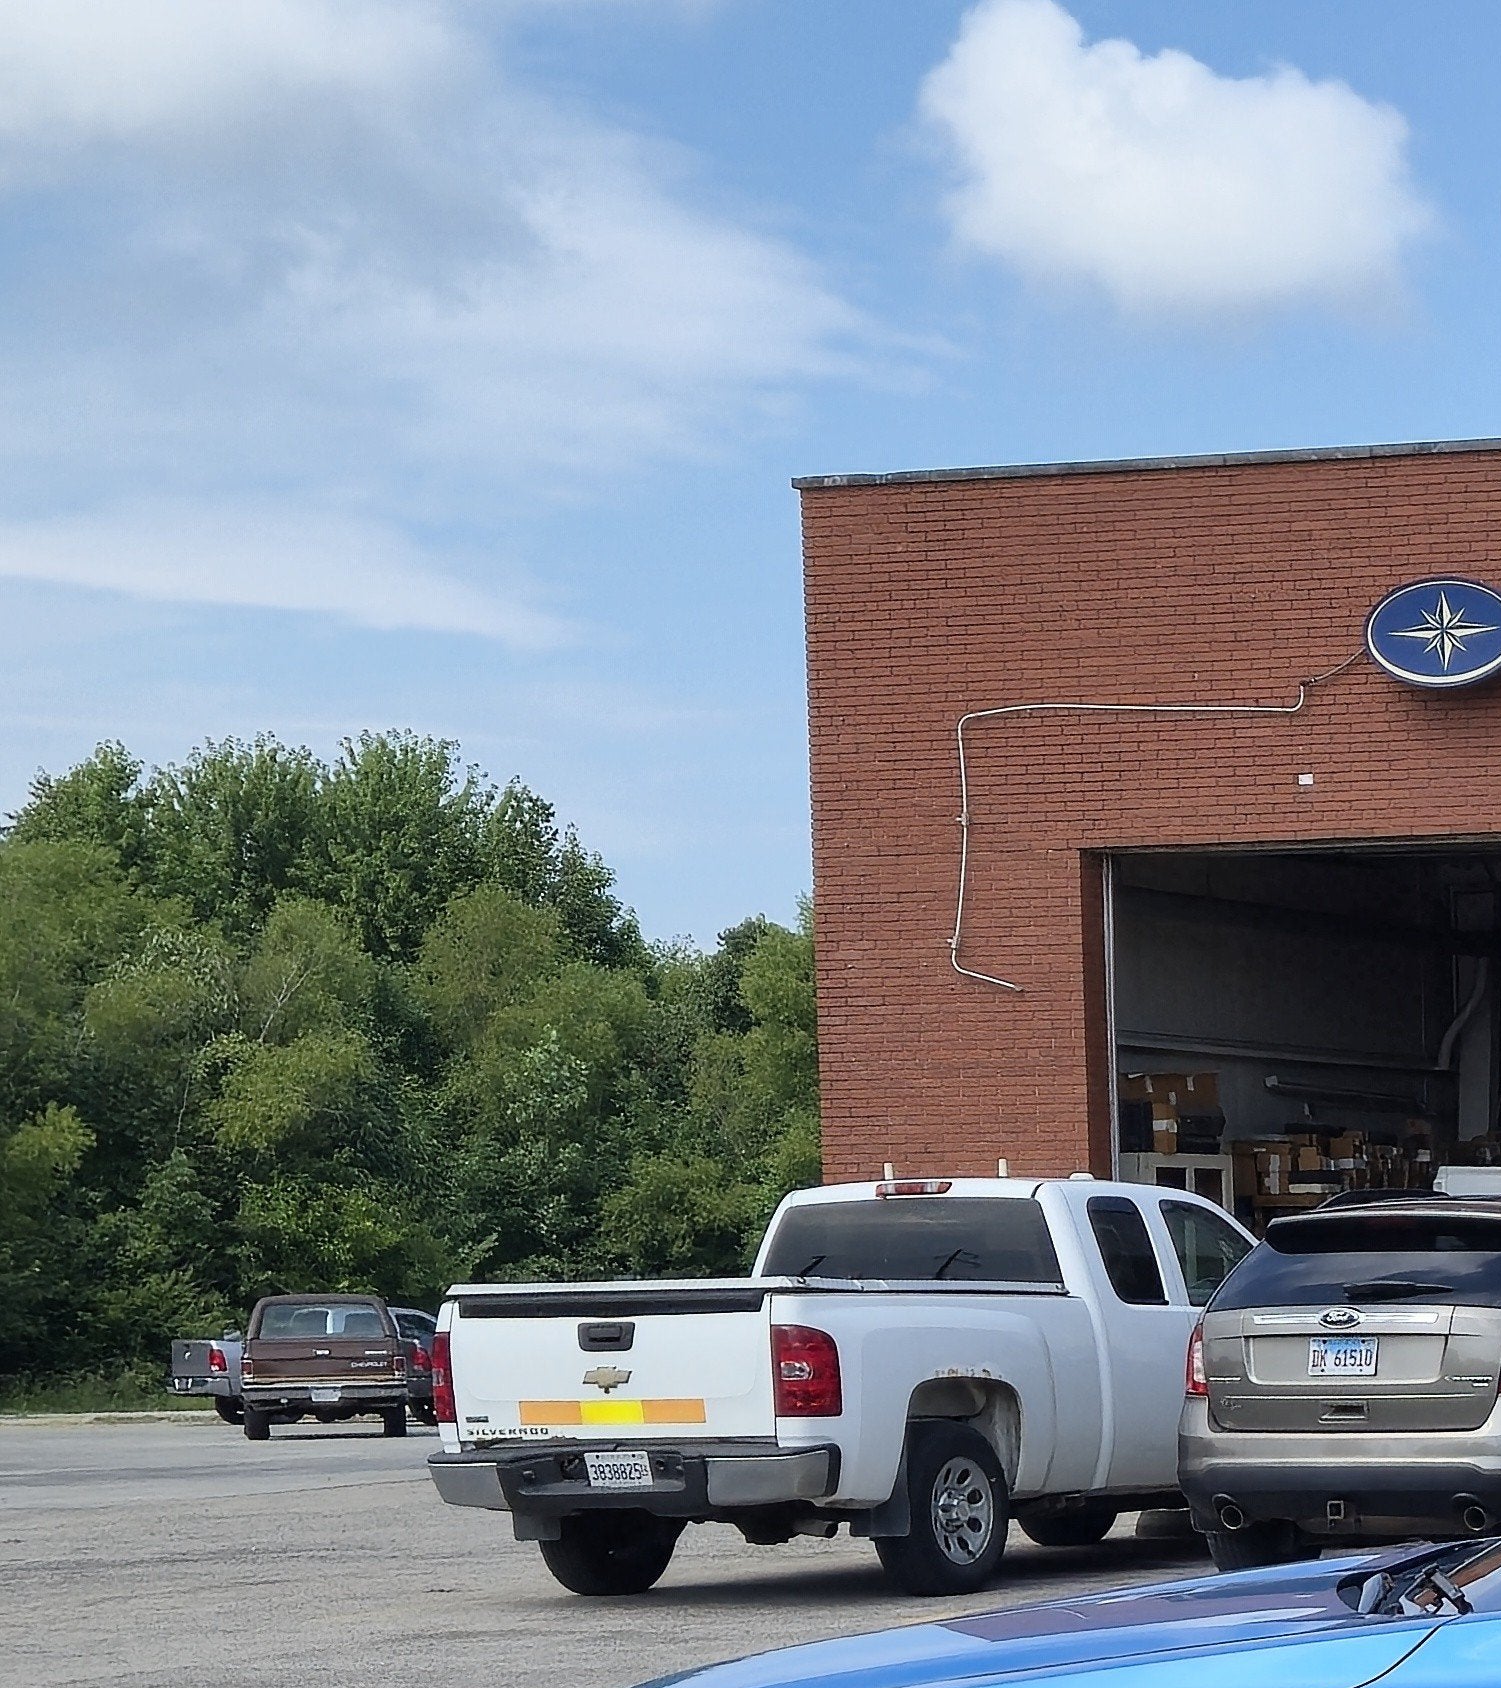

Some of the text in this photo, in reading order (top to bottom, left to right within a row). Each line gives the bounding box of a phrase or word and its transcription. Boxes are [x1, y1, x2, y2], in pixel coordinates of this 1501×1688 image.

[1312, 1349, 1373, 1367] DK 61510
[590, 1462, 642, 1481] 3838825
